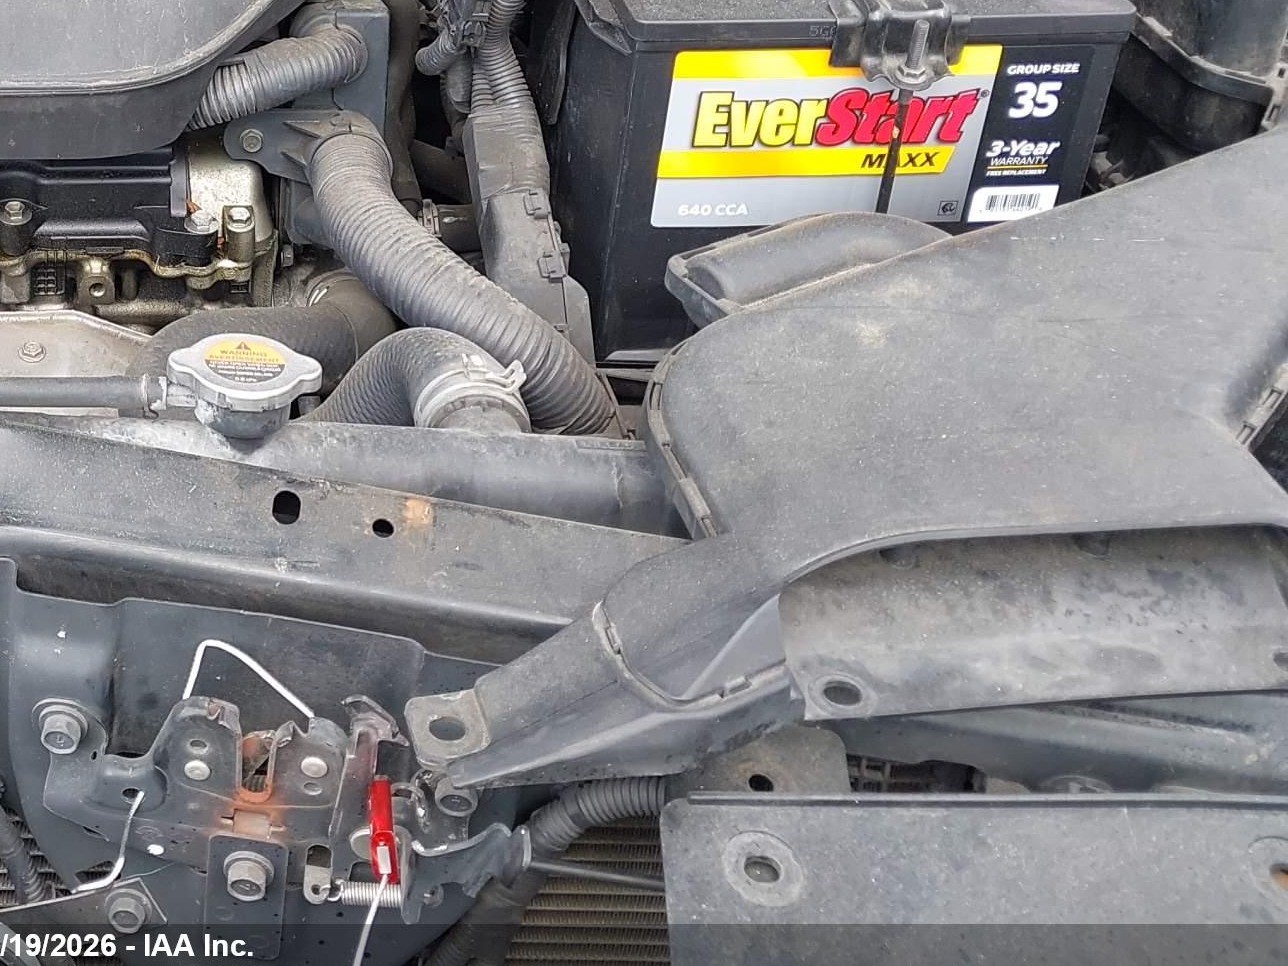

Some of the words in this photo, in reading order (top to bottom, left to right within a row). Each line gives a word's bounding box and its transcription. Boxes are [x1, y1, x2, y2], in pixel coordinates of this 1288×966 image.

[1007, 64, 1051, 75] GROUP
[1051, 63, 1080, 74] SIZE
[1008, 81, 1063, 119] 35
[692, 87, 981, 148] EverStart
[986, 139, 1060, 158] 3-Year
[861, 151, 941, 169] MXX
[990, 156, 1049, 166] WARRANTY
[1002, 168, 1047, 176] REPLACEMENT
[678, 204, 713, 217] 640
[715, 203, 749, 216] CCA
